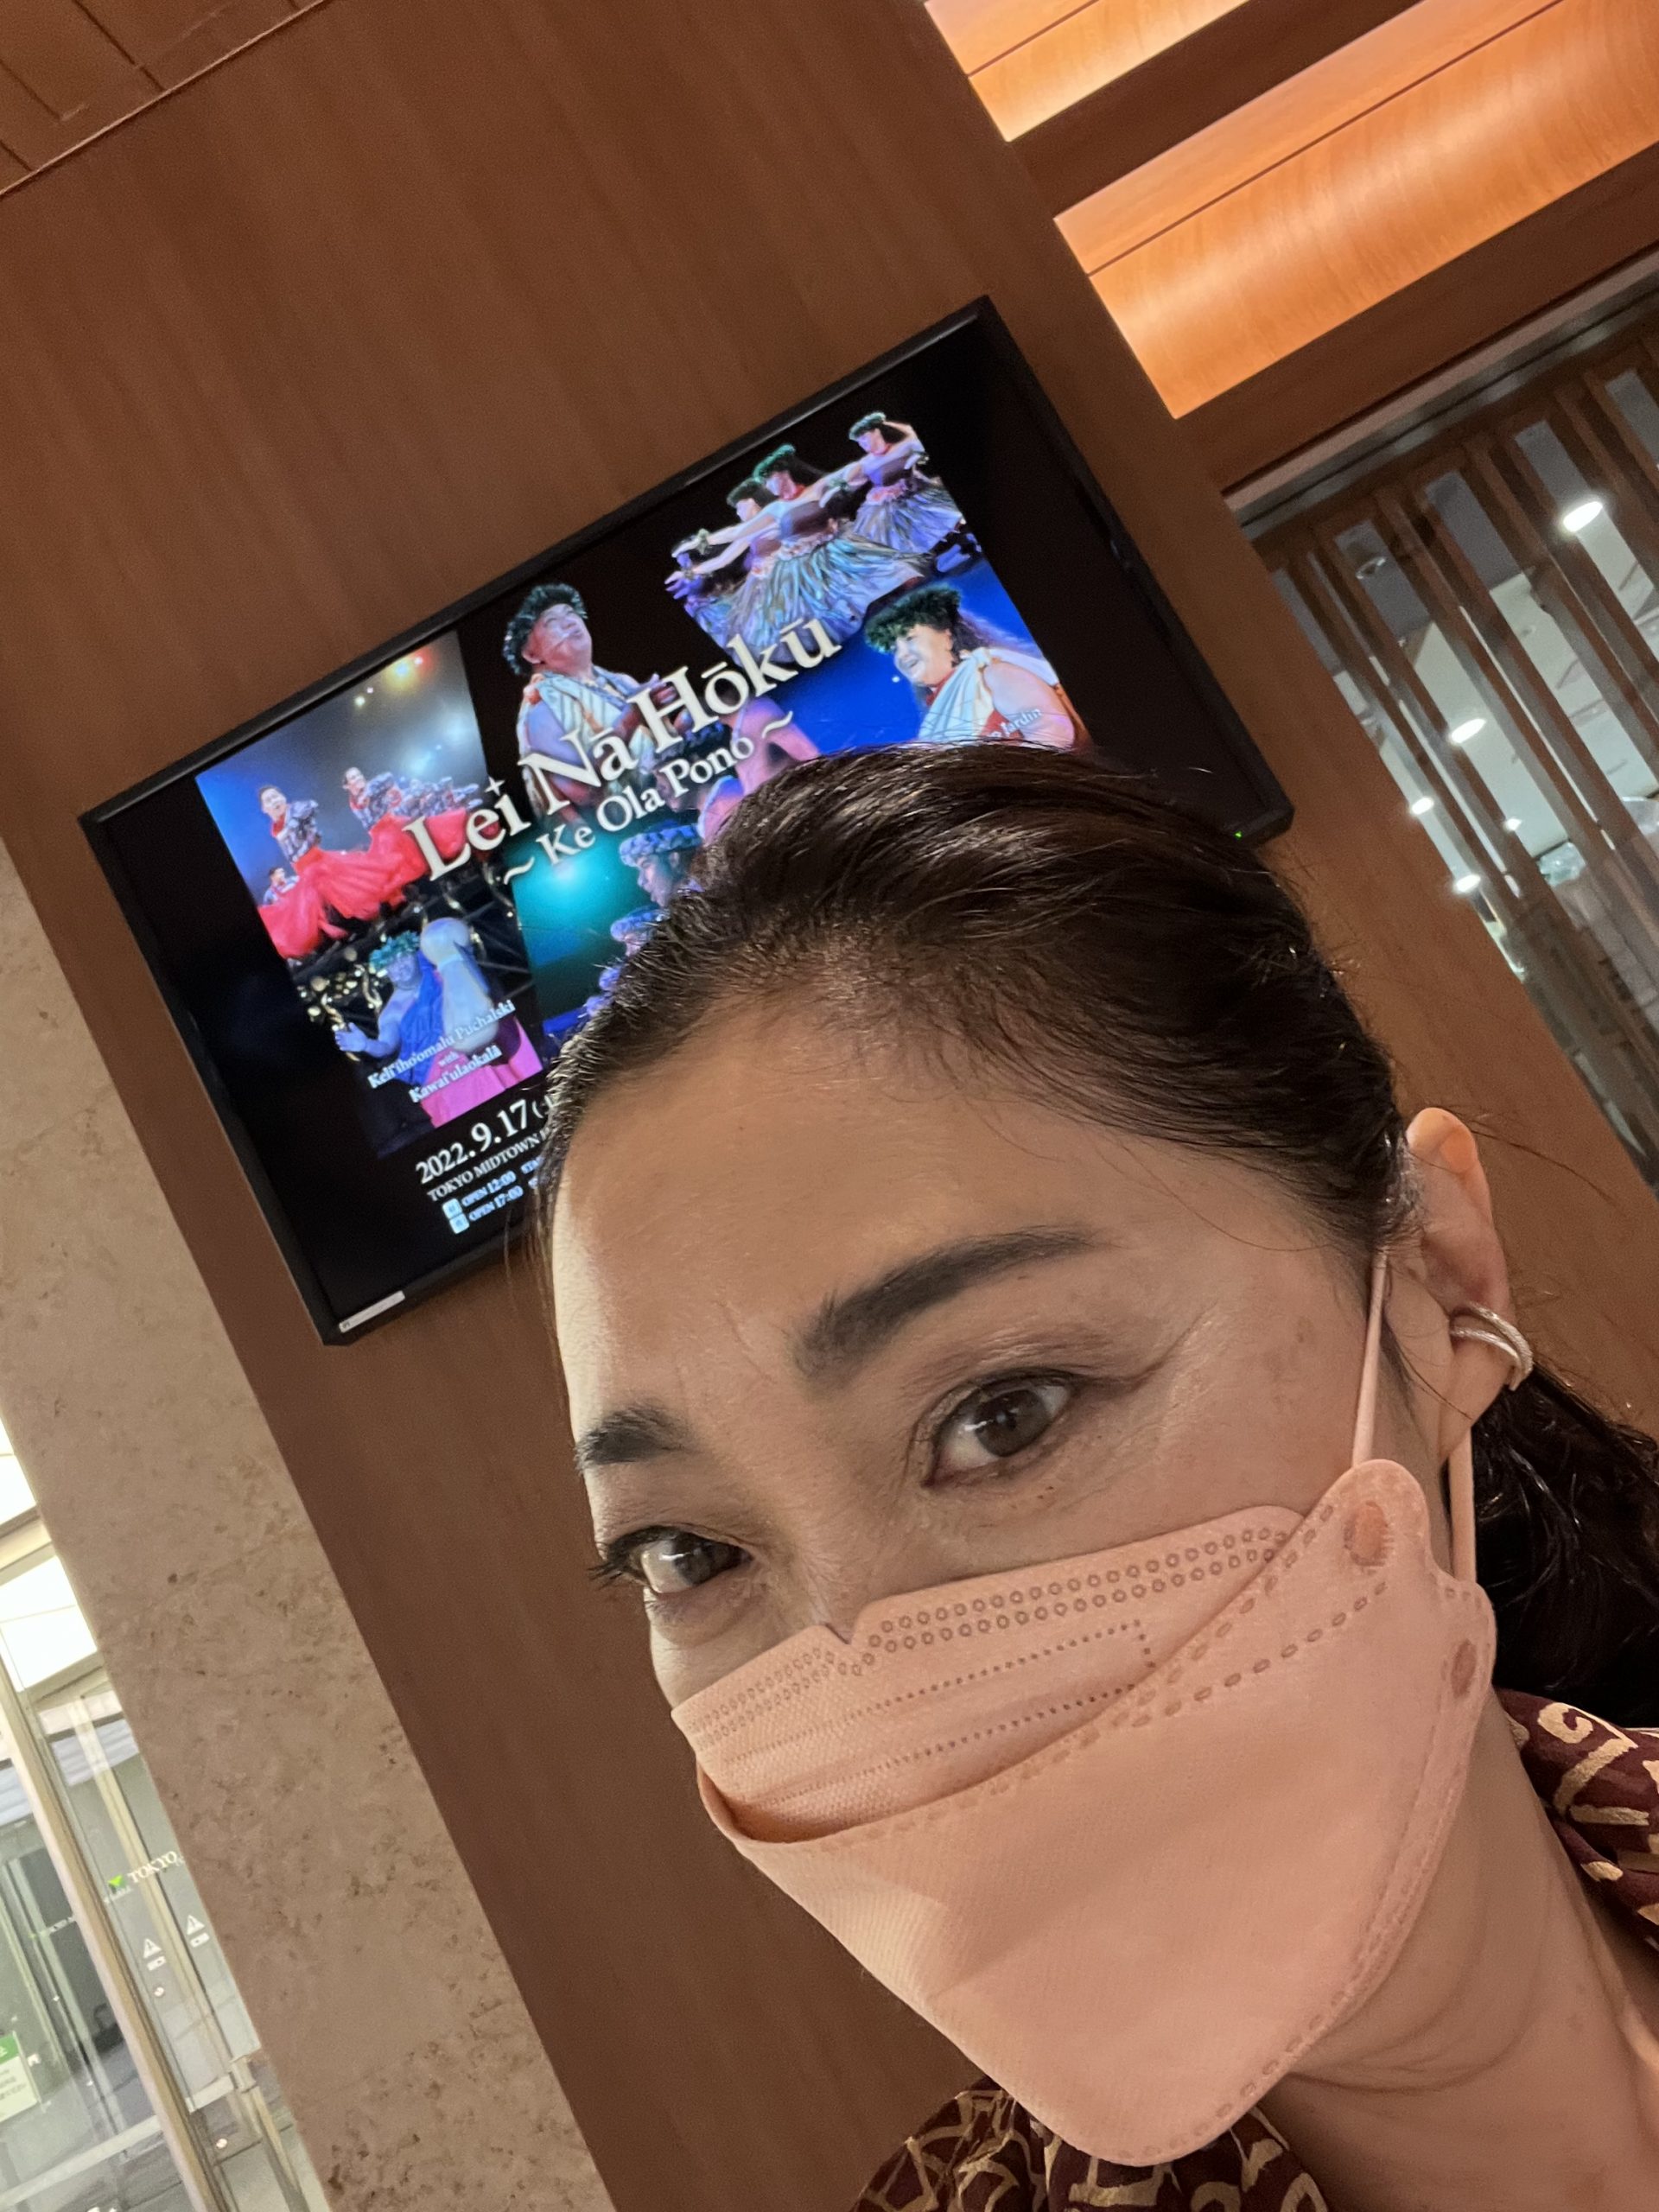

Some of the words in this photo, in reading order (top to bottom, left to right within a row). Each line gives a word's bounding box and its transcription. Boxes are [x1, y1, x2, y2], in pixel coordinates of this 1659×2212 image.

[403, 776, 531, 881] Lei
[518, 727, 640, 815] Nā
[627, 617, 842, 753] Hōkū
[535, 823, 596, 865] Ke
[596, 785, 665, 832] Ola
[659, 737, 754, 798] Pono
[438, 1052, 460, 1067] with
[427, 1171, 474, 1202] TOKYO
[473, 1133, 540, 1179] MIDTOWN
[127, 1851, 177, 1883] TOKYO
